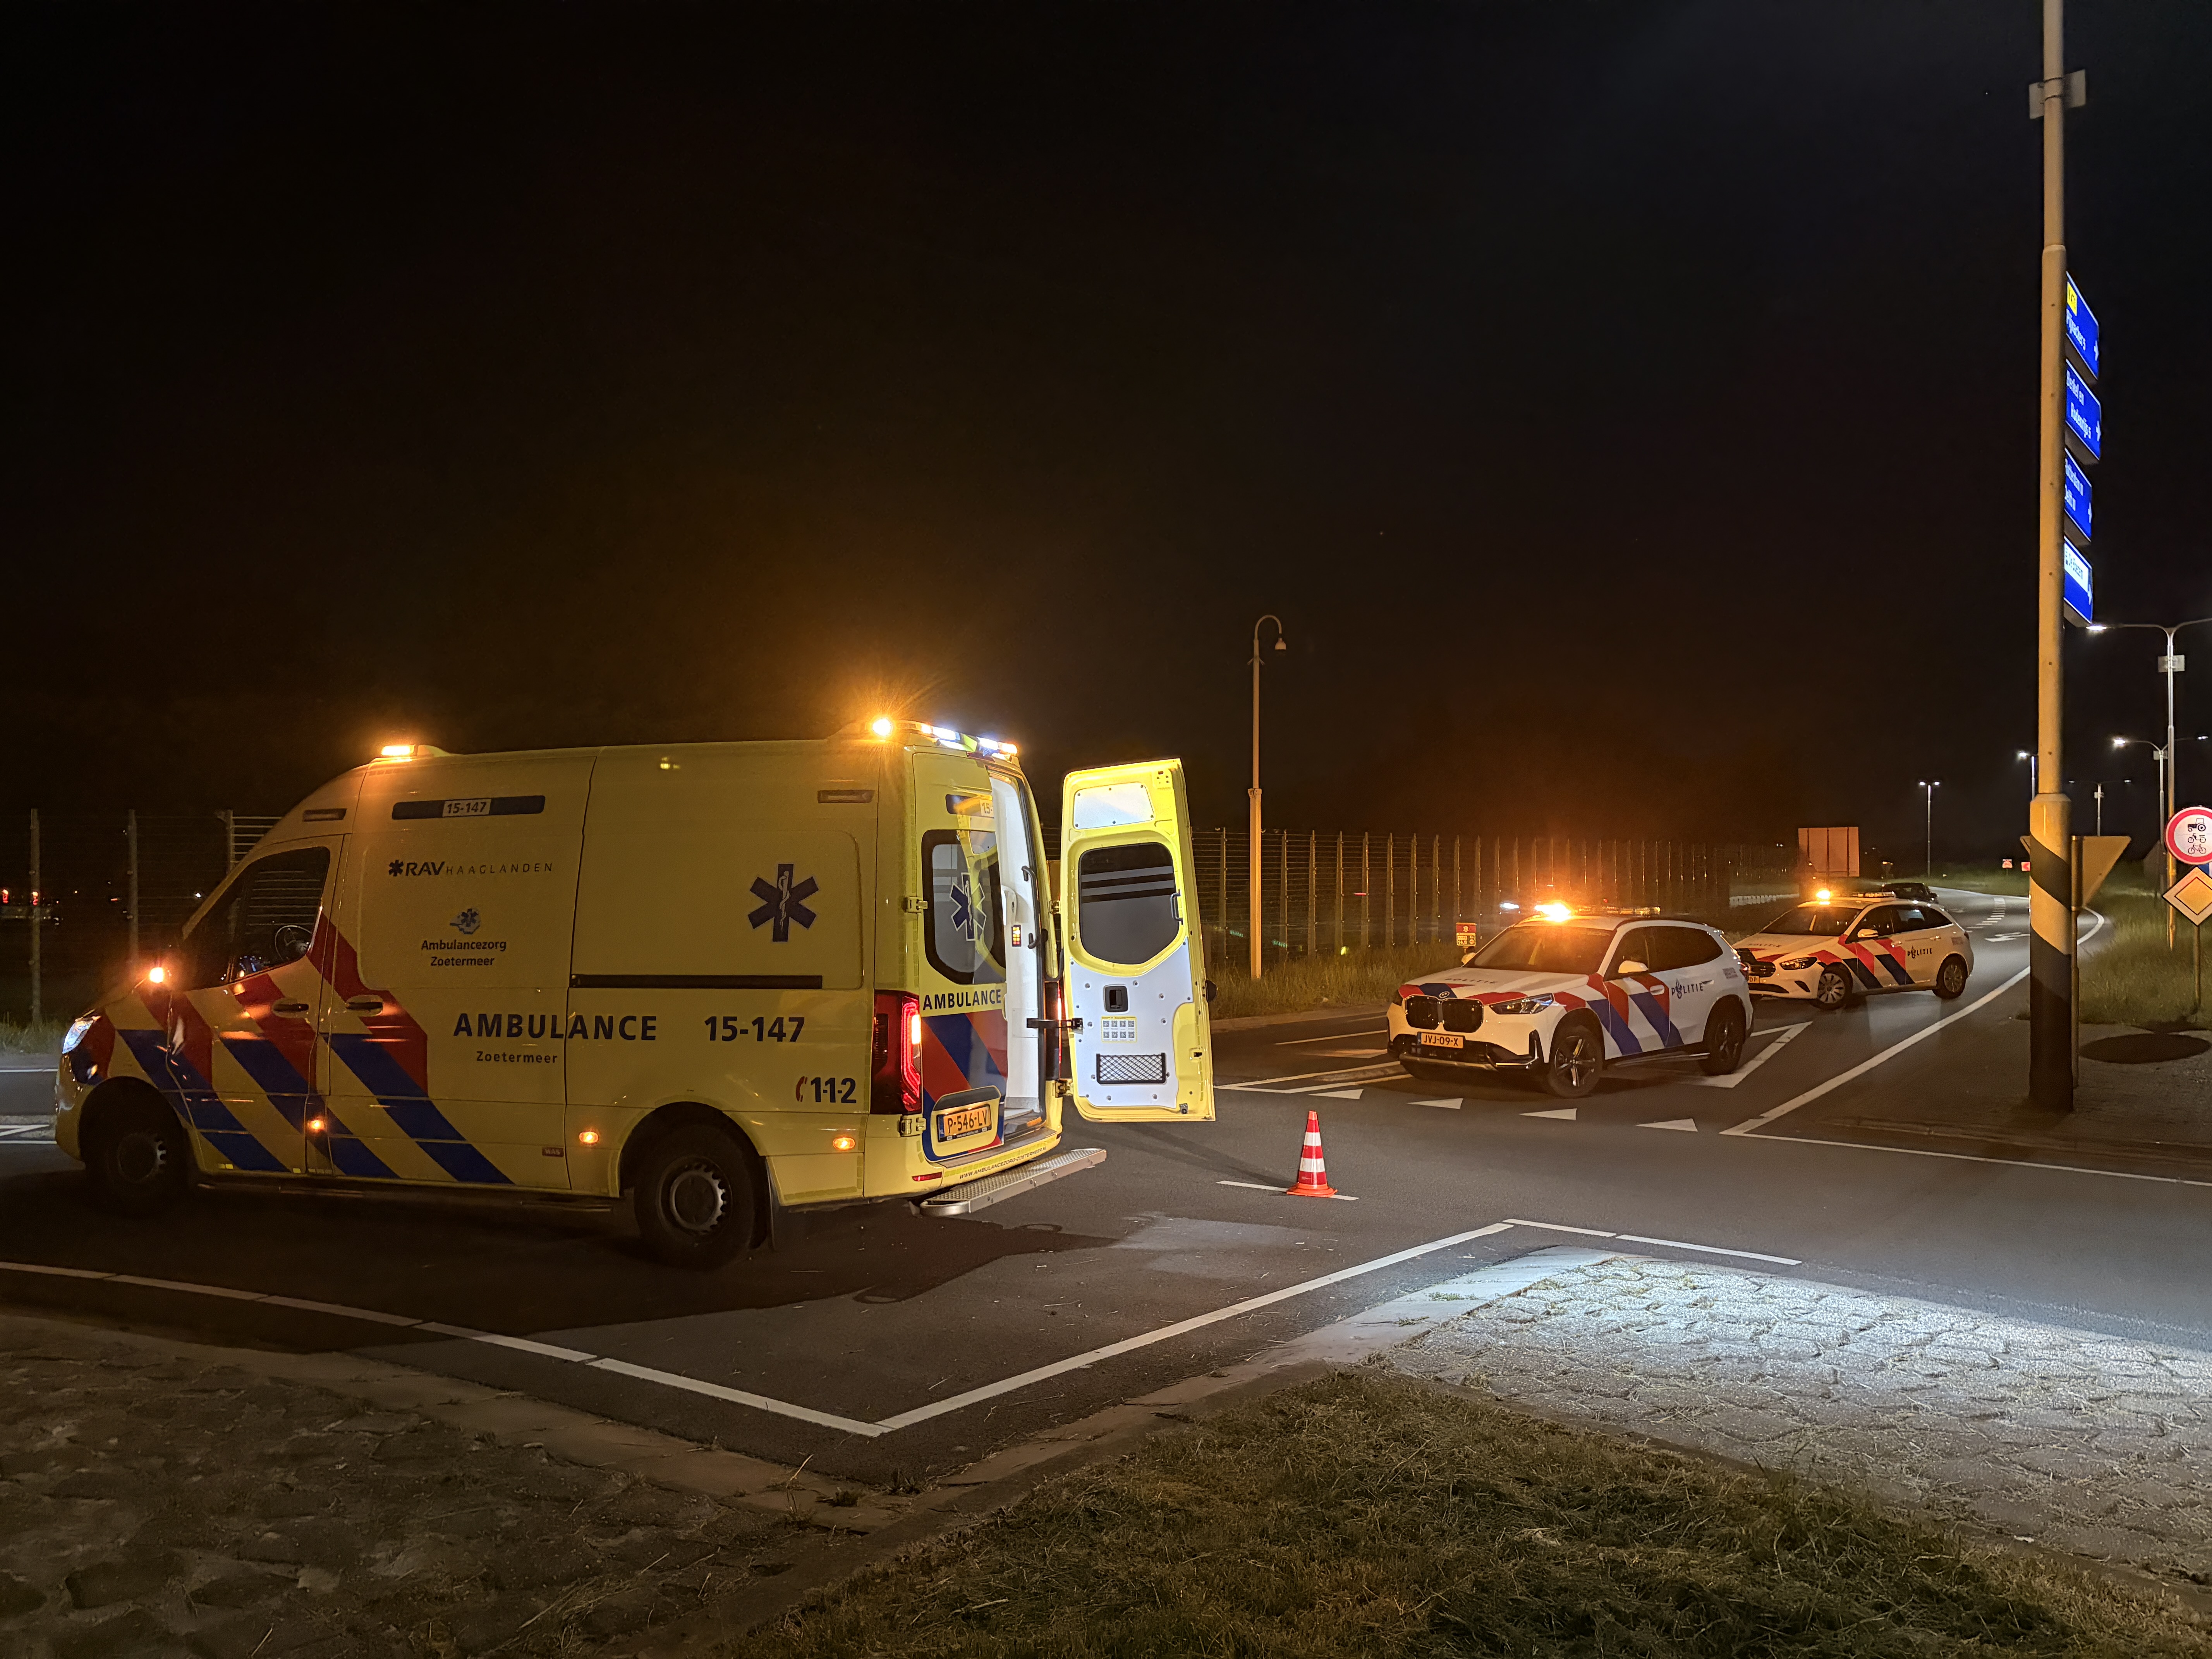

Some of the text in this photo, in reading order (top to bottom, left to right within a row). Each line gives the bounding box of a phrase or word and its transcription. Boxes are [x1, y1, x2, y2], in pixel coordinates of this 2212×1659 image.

[447, 802, 487, 814] 15-147
[405, 861, 552, 876] RAV HAAGLANDEN
[421, 939, 507, 952] Ambulancezorg
[1907, 947, 1932, 958] POLITIE
[431, 956, 495, 966] Zoetermeer
[1671, 982, 1704, 999] POLITIE
[923, 989, 1001, 1010] AMBULANCE
[453, 1013, 656, 1041] AMBULANCE
[704, 1016, 805, 1042] 15-147
[1424, 1035, 1458, 1046] JVJ-09-X
[476, 1051, 558, 1063] Zoetermeer
[948, 1109, 987, 1133] P-546-LV
